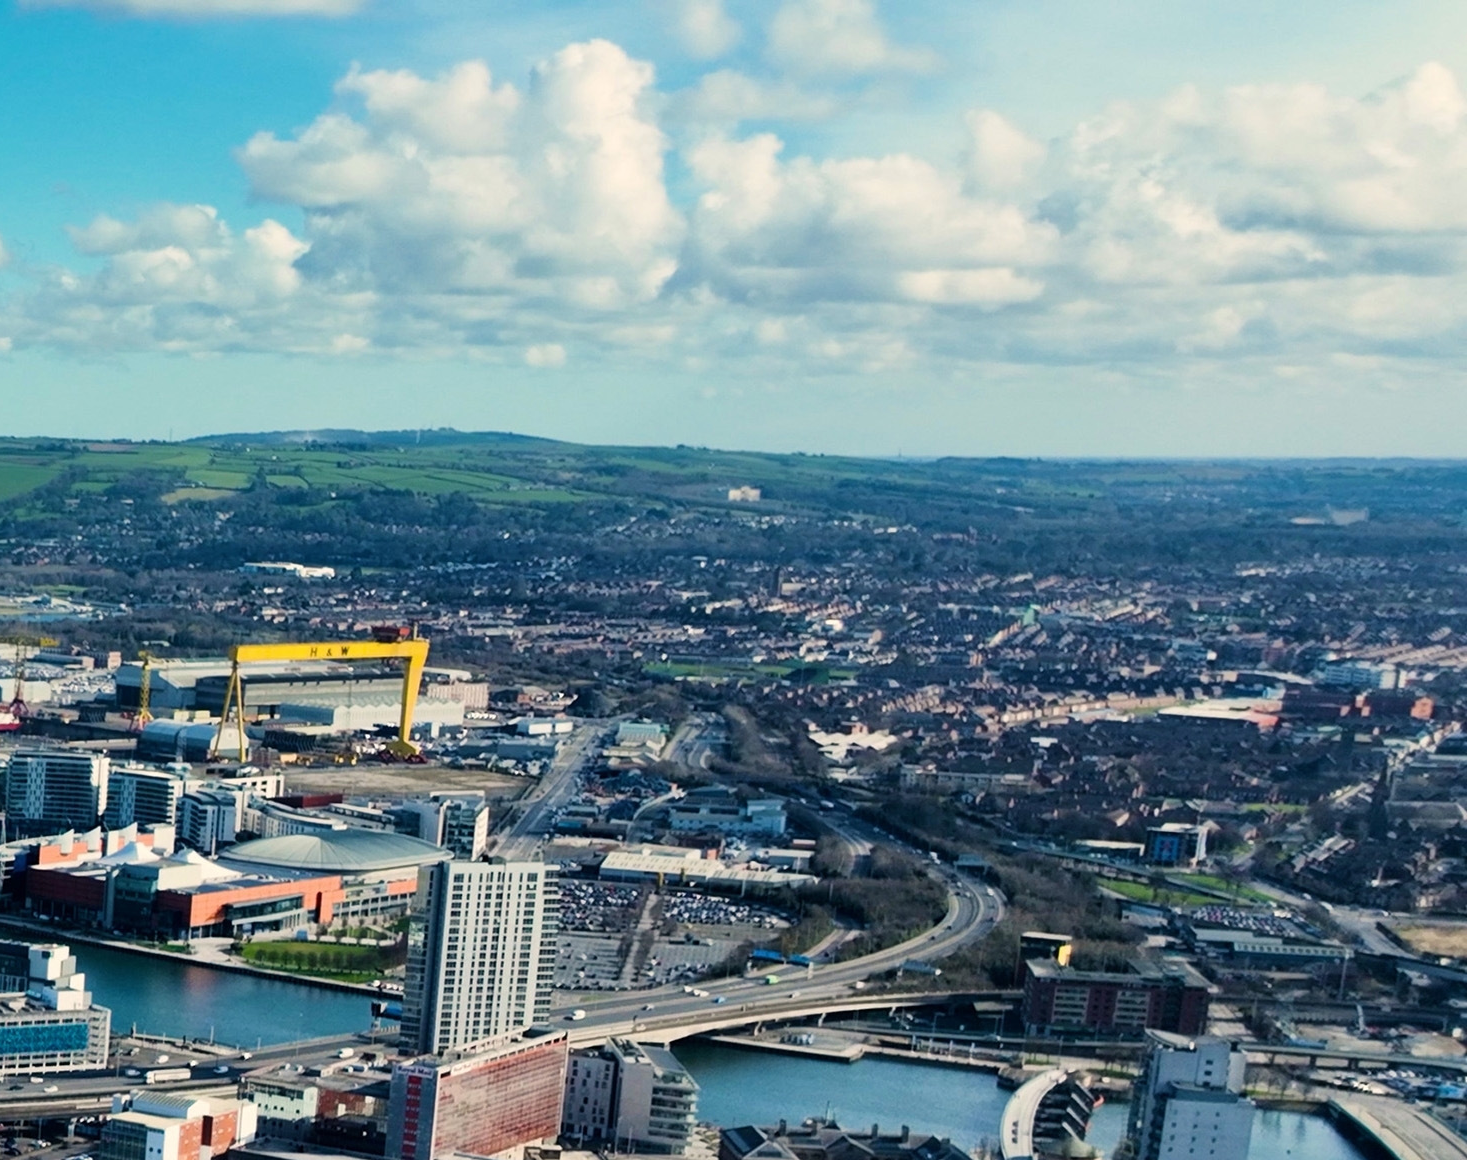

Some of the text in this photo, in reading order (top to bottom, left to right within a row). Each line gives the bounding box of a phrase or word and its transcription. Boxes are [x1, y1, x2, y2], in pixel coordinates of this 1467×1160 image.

[310, 647, 318, 657] H
[341, 646, 349, 656] W
[398, 1066, 432, 1075] Royal Mail
